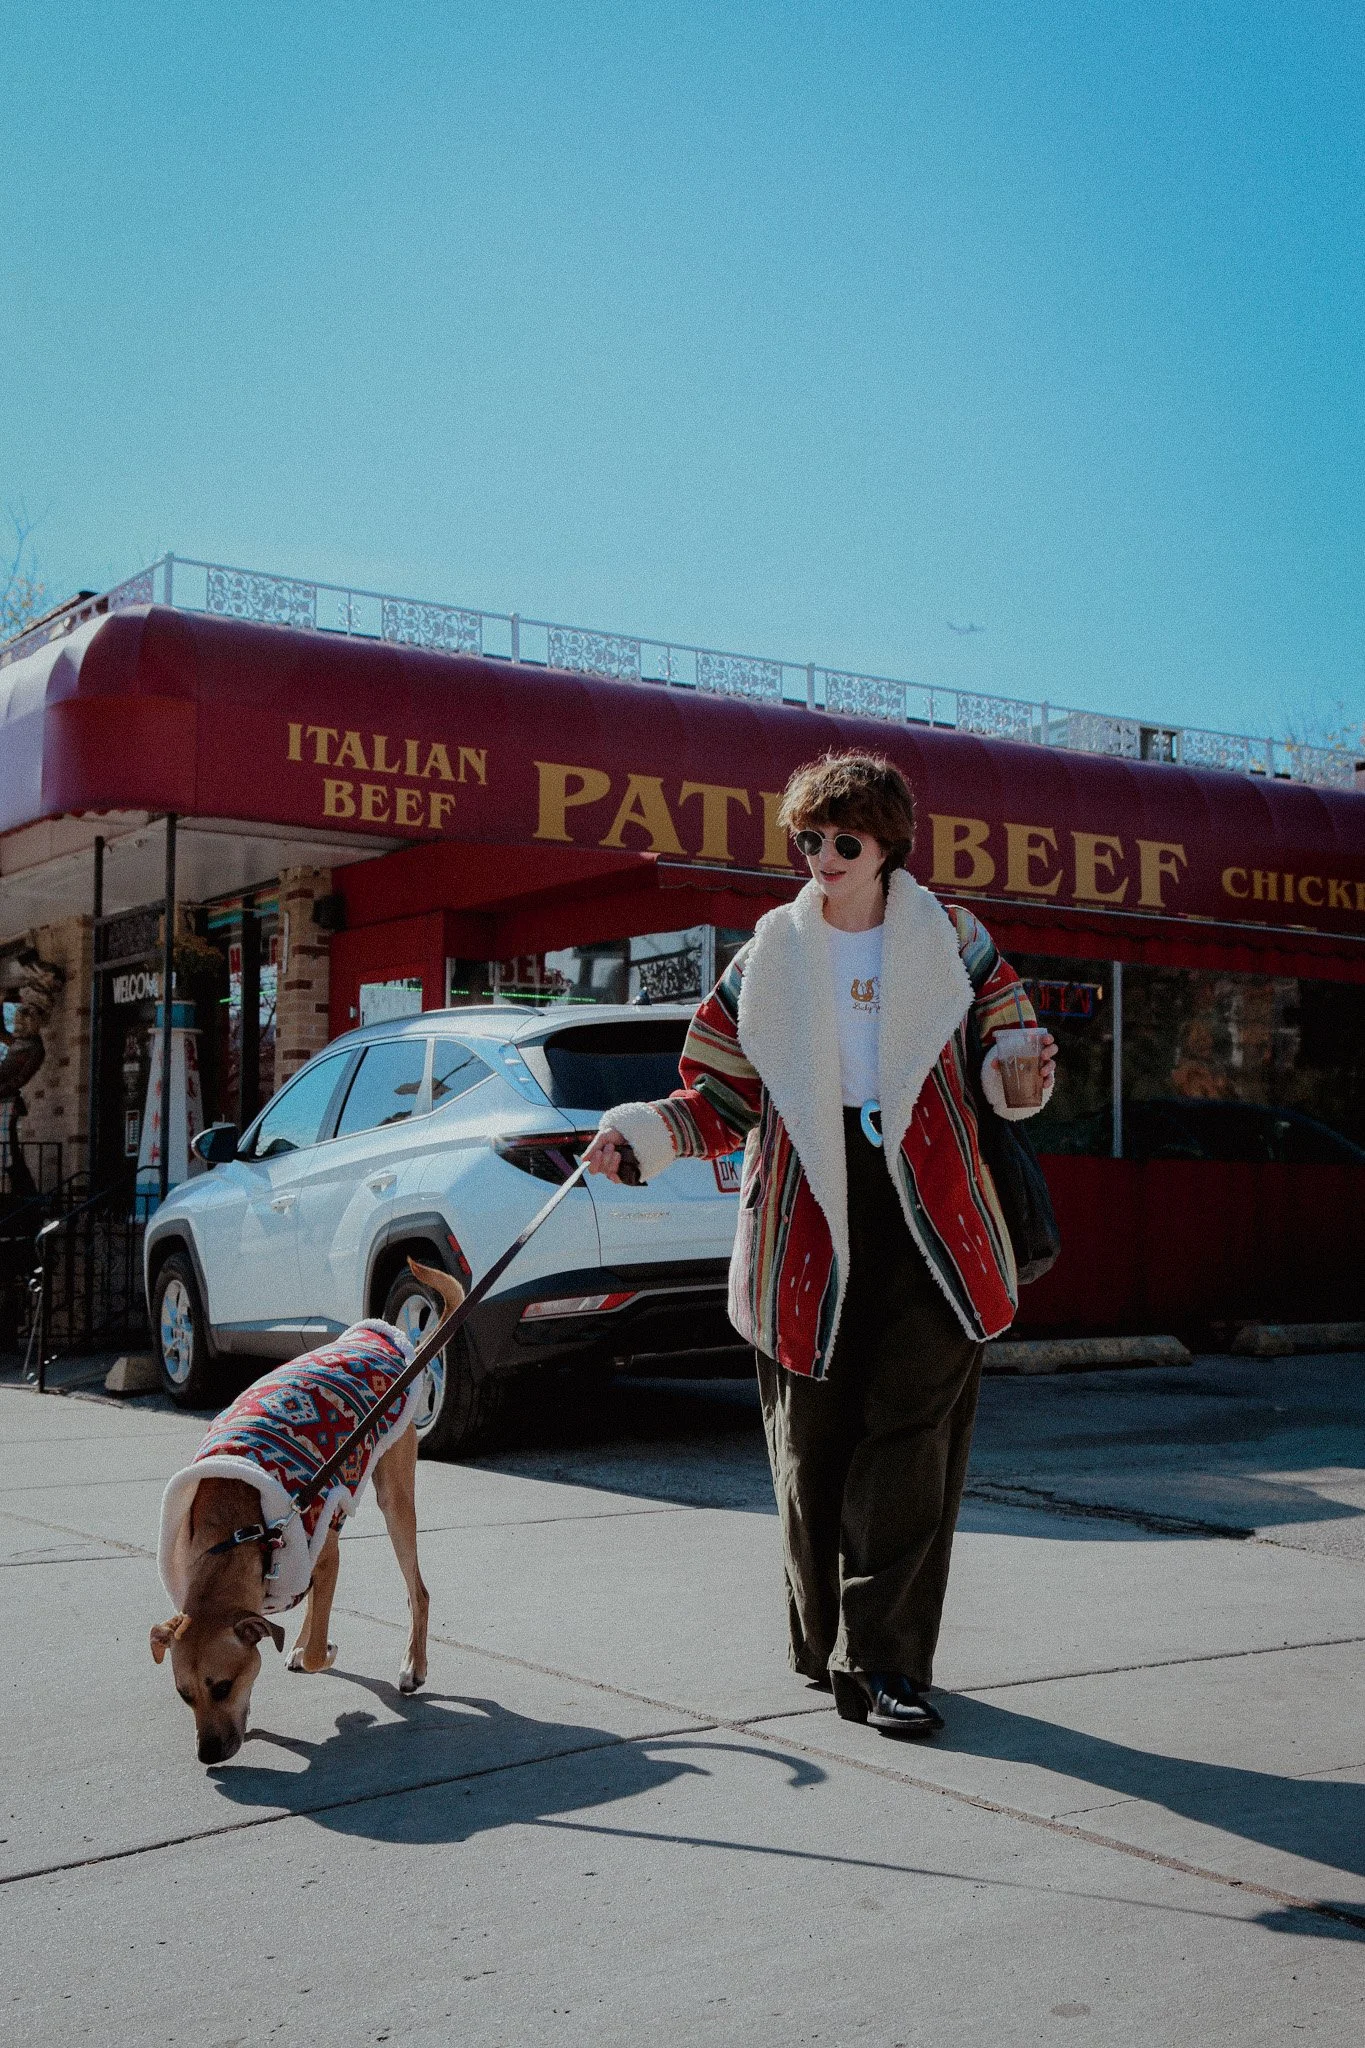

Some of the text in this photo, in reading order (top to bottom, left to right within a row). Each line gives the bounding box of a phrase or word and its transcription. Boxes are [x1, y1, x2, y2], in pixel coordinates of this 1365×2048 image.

[286, 722, 489, 786] ITALIAN
[322, 778, 457, 830] BEEF
[532, 760, 1189, 909] PATI BEEF
[112, 971, 178, 1005] WELCOM
